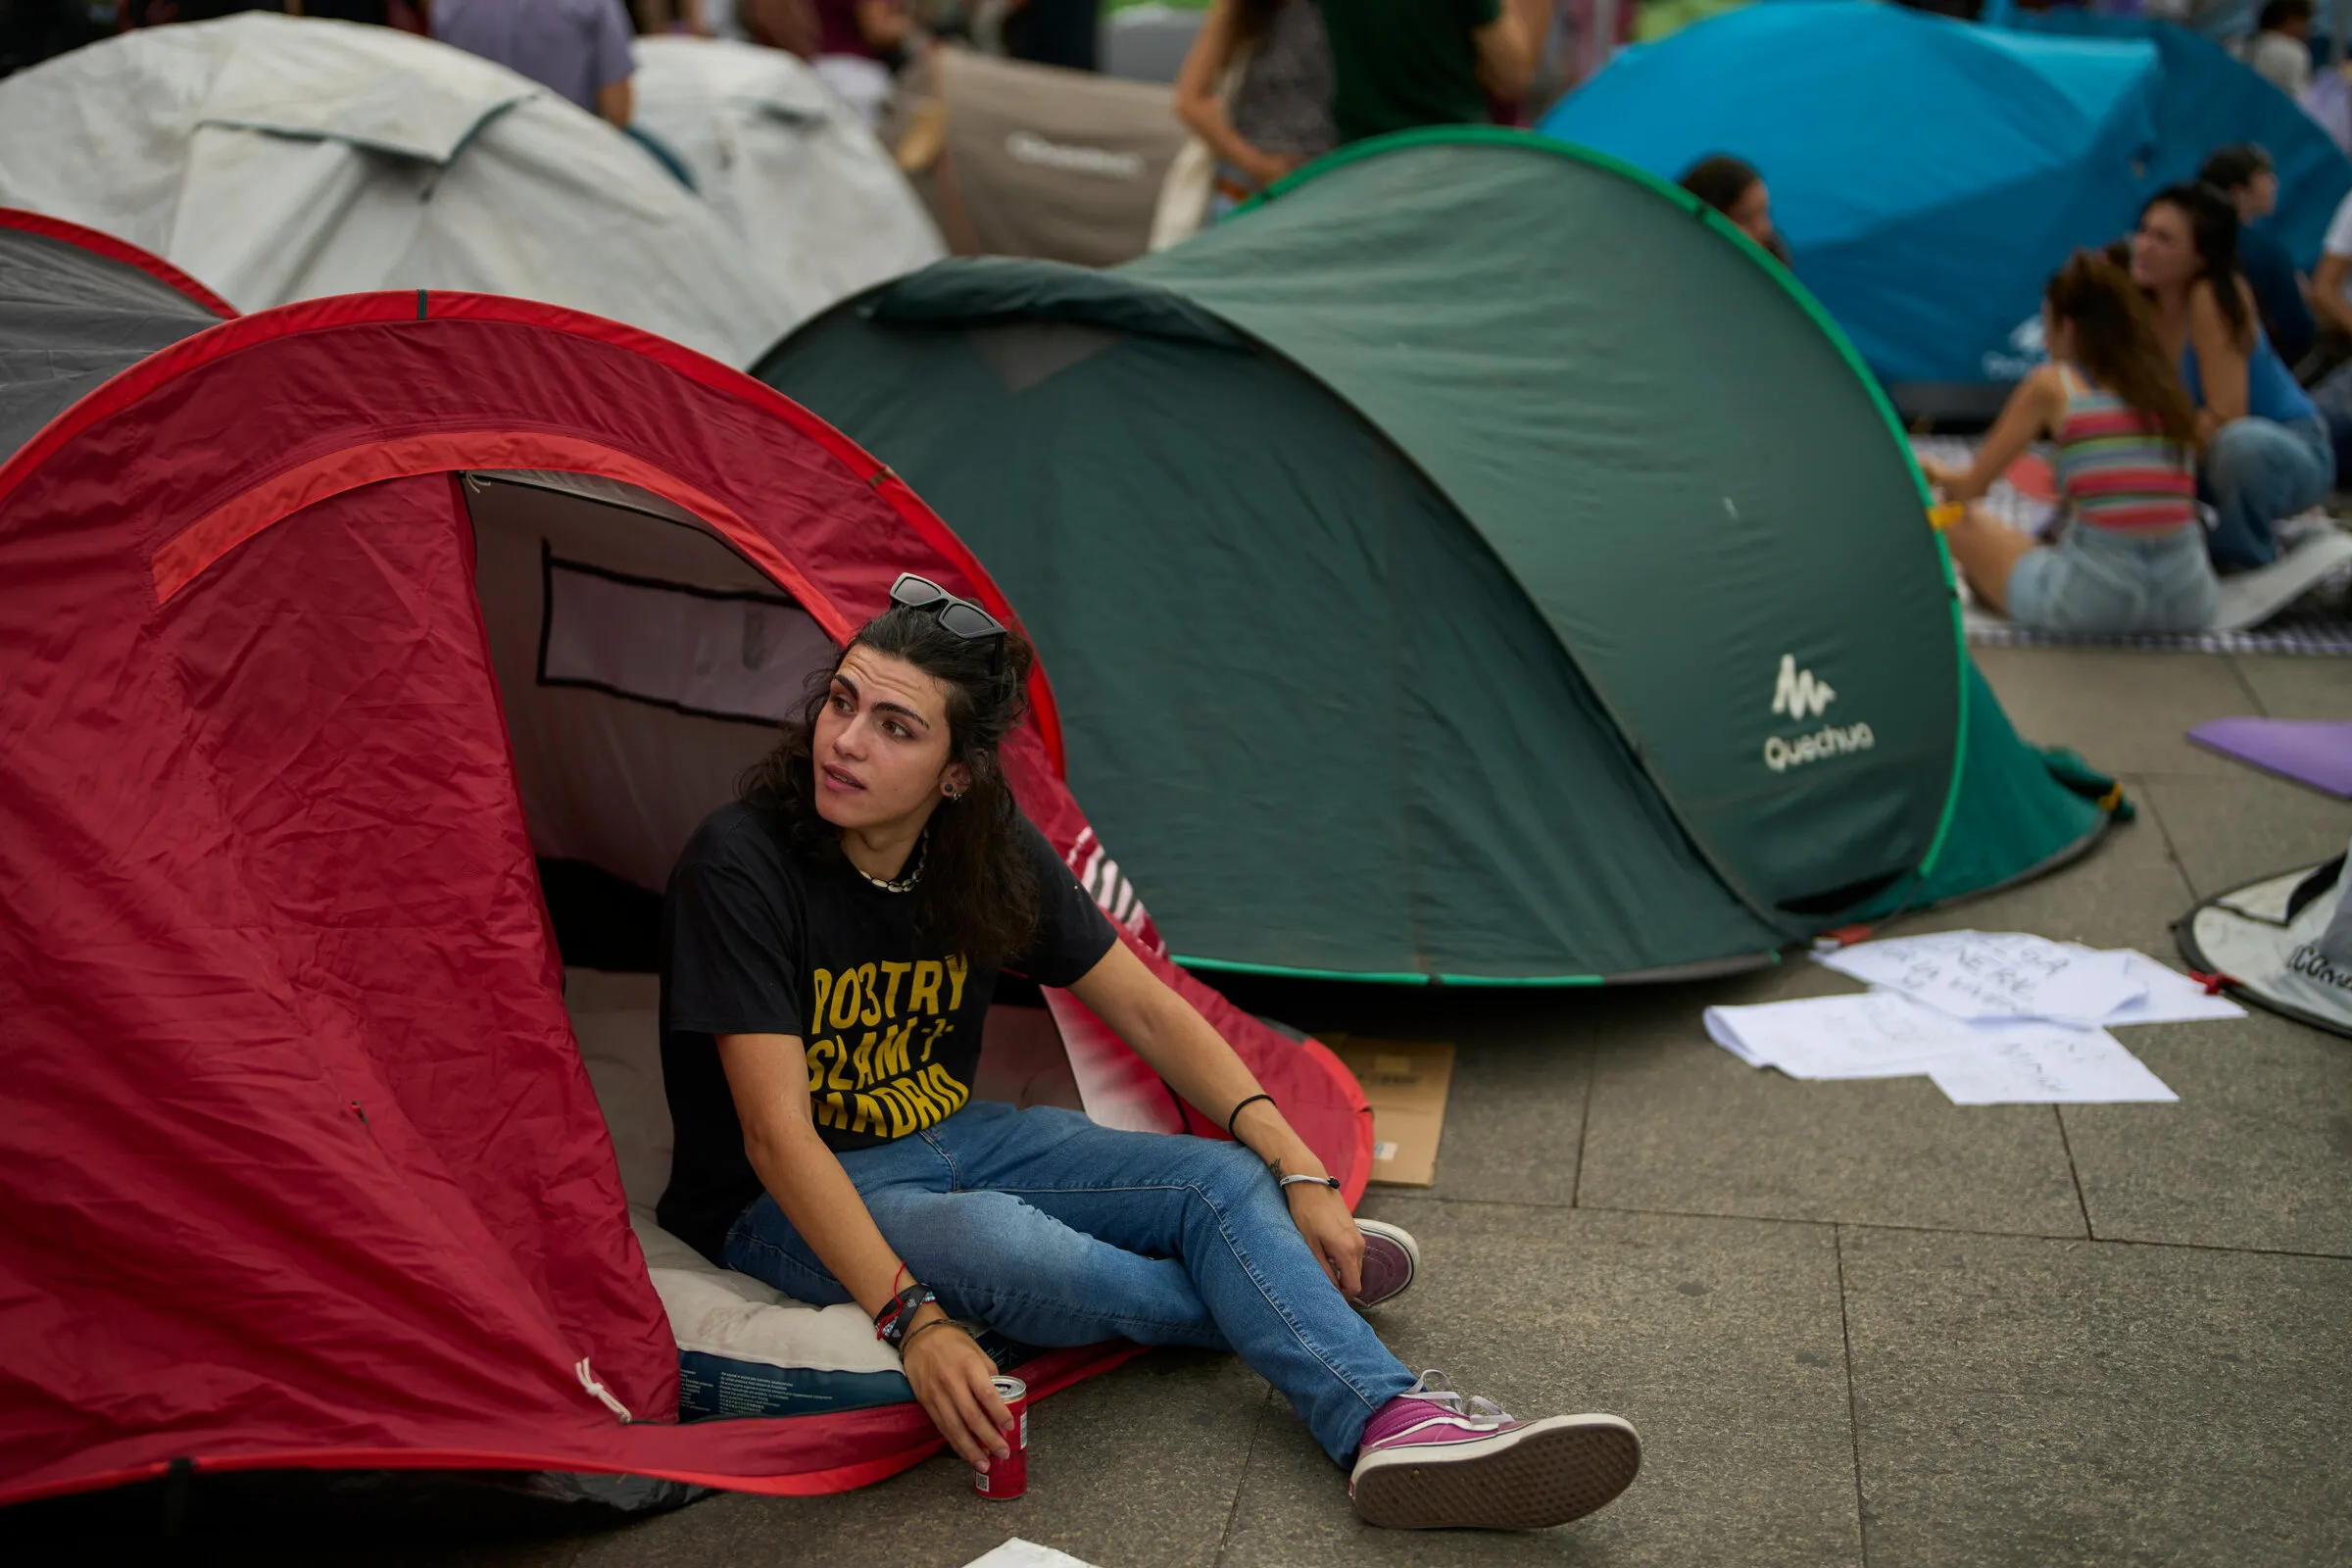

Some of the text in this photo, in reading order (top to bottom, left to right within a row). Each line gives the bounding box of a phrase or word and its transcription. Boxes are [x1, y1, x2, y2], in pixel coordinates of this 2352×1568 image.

[1765, 721, 1875, 772] Quechua
[806, 1016, 918, 1092] SLAM
[811, 1062, 969, 1139] MADRID
